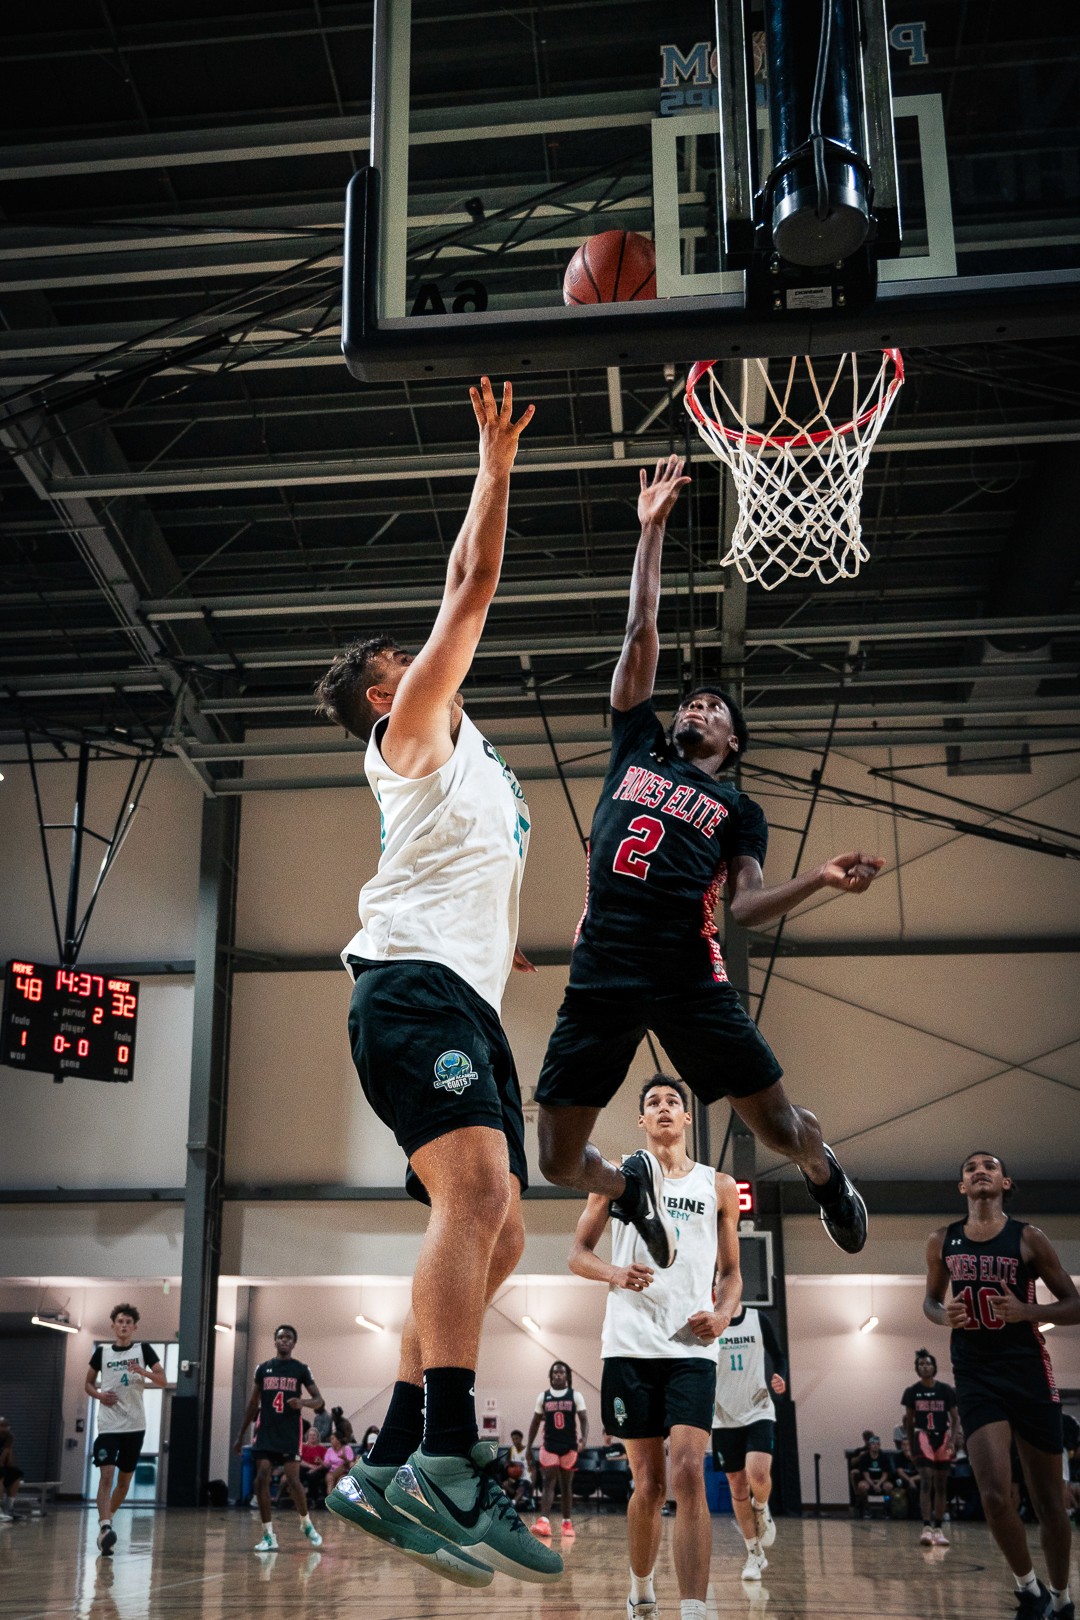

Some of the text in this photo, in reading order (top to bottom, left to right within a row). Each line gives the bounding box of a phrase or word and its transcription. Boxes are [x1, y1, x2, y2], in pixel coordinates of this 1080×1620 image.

[660, 784, 728, 839] ELITE
[612, 814, 665, 881] 2
[12, 962, 34, 976] HOME
[15, 976, 42, 1001] 48
[56, 970, 104, 998] 14:37
[107, 980, 131, 993] GUEST
[111, 992, 136, 1018] 32
[62, 1007, 104, 1025] period 2
[60, 1022, 86, 1034] player
[21, 1031, 28, 1046] 1
[117, 1045, 129, 1063] 0
[60, 1059, 80, 1069] game
[663, 1196, 705, 1216] BINE
[979, 1255, 1019, 1285] ELITE
[963, 1285, 1006, 1330] 10
[718, 1335, 756, 1345] OMBINE
[730, 1353, 744, 1371] 11
[120, 1373, 129, 1387] 4
[272, 1391, 285, 1413] 4
[553, 1411, 565, 1430] 0
[926, 1412, 936, 1430] 1
